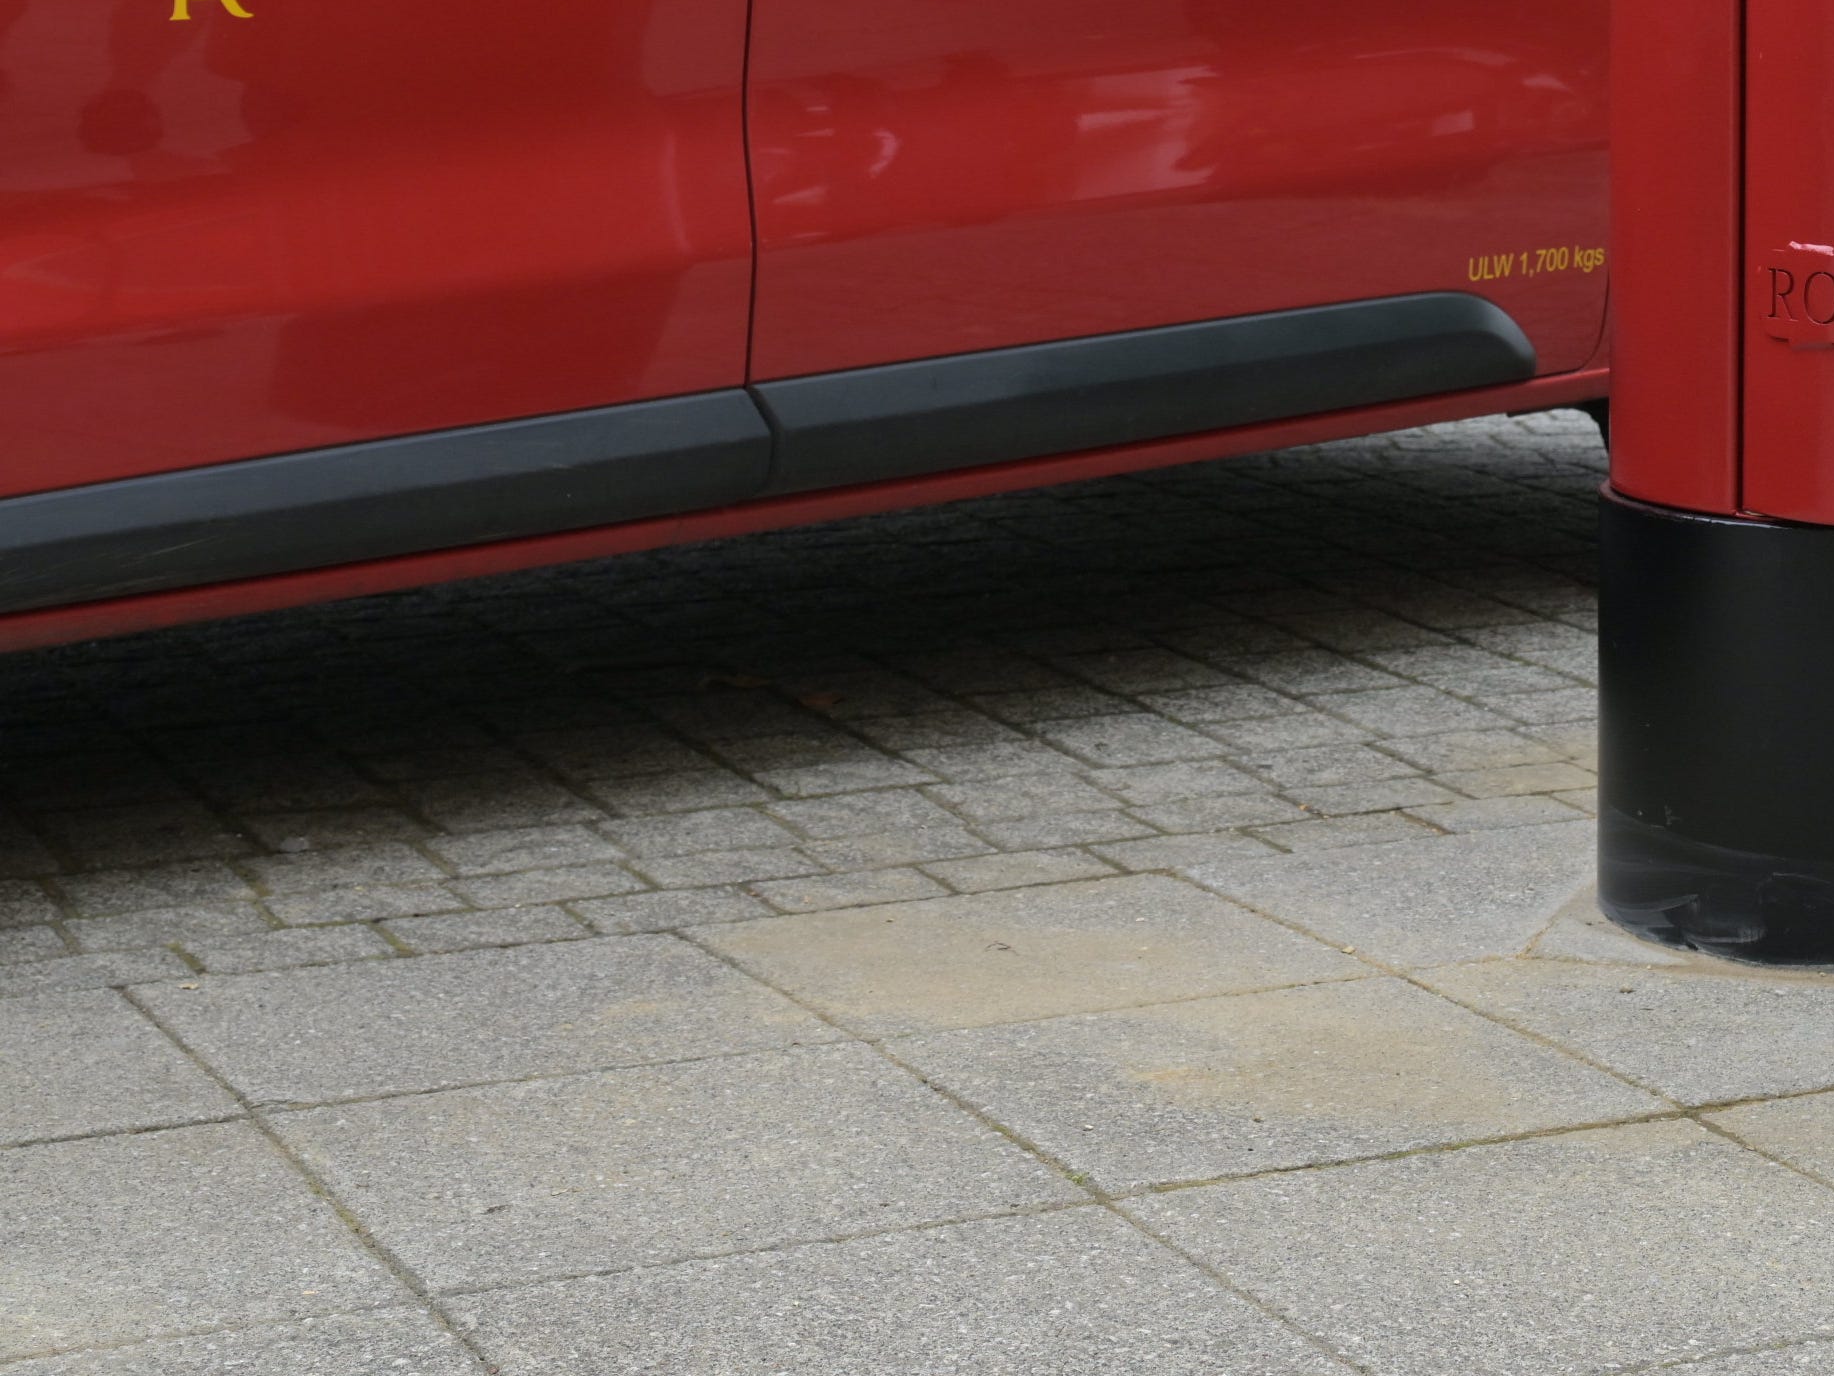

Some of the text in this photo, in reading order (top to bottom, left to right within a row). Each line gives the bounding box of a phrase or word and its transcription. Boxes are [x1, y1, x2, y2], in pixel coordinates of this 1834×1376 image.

[1468, 245, 1605, 282] ULW 1,700 kgs
